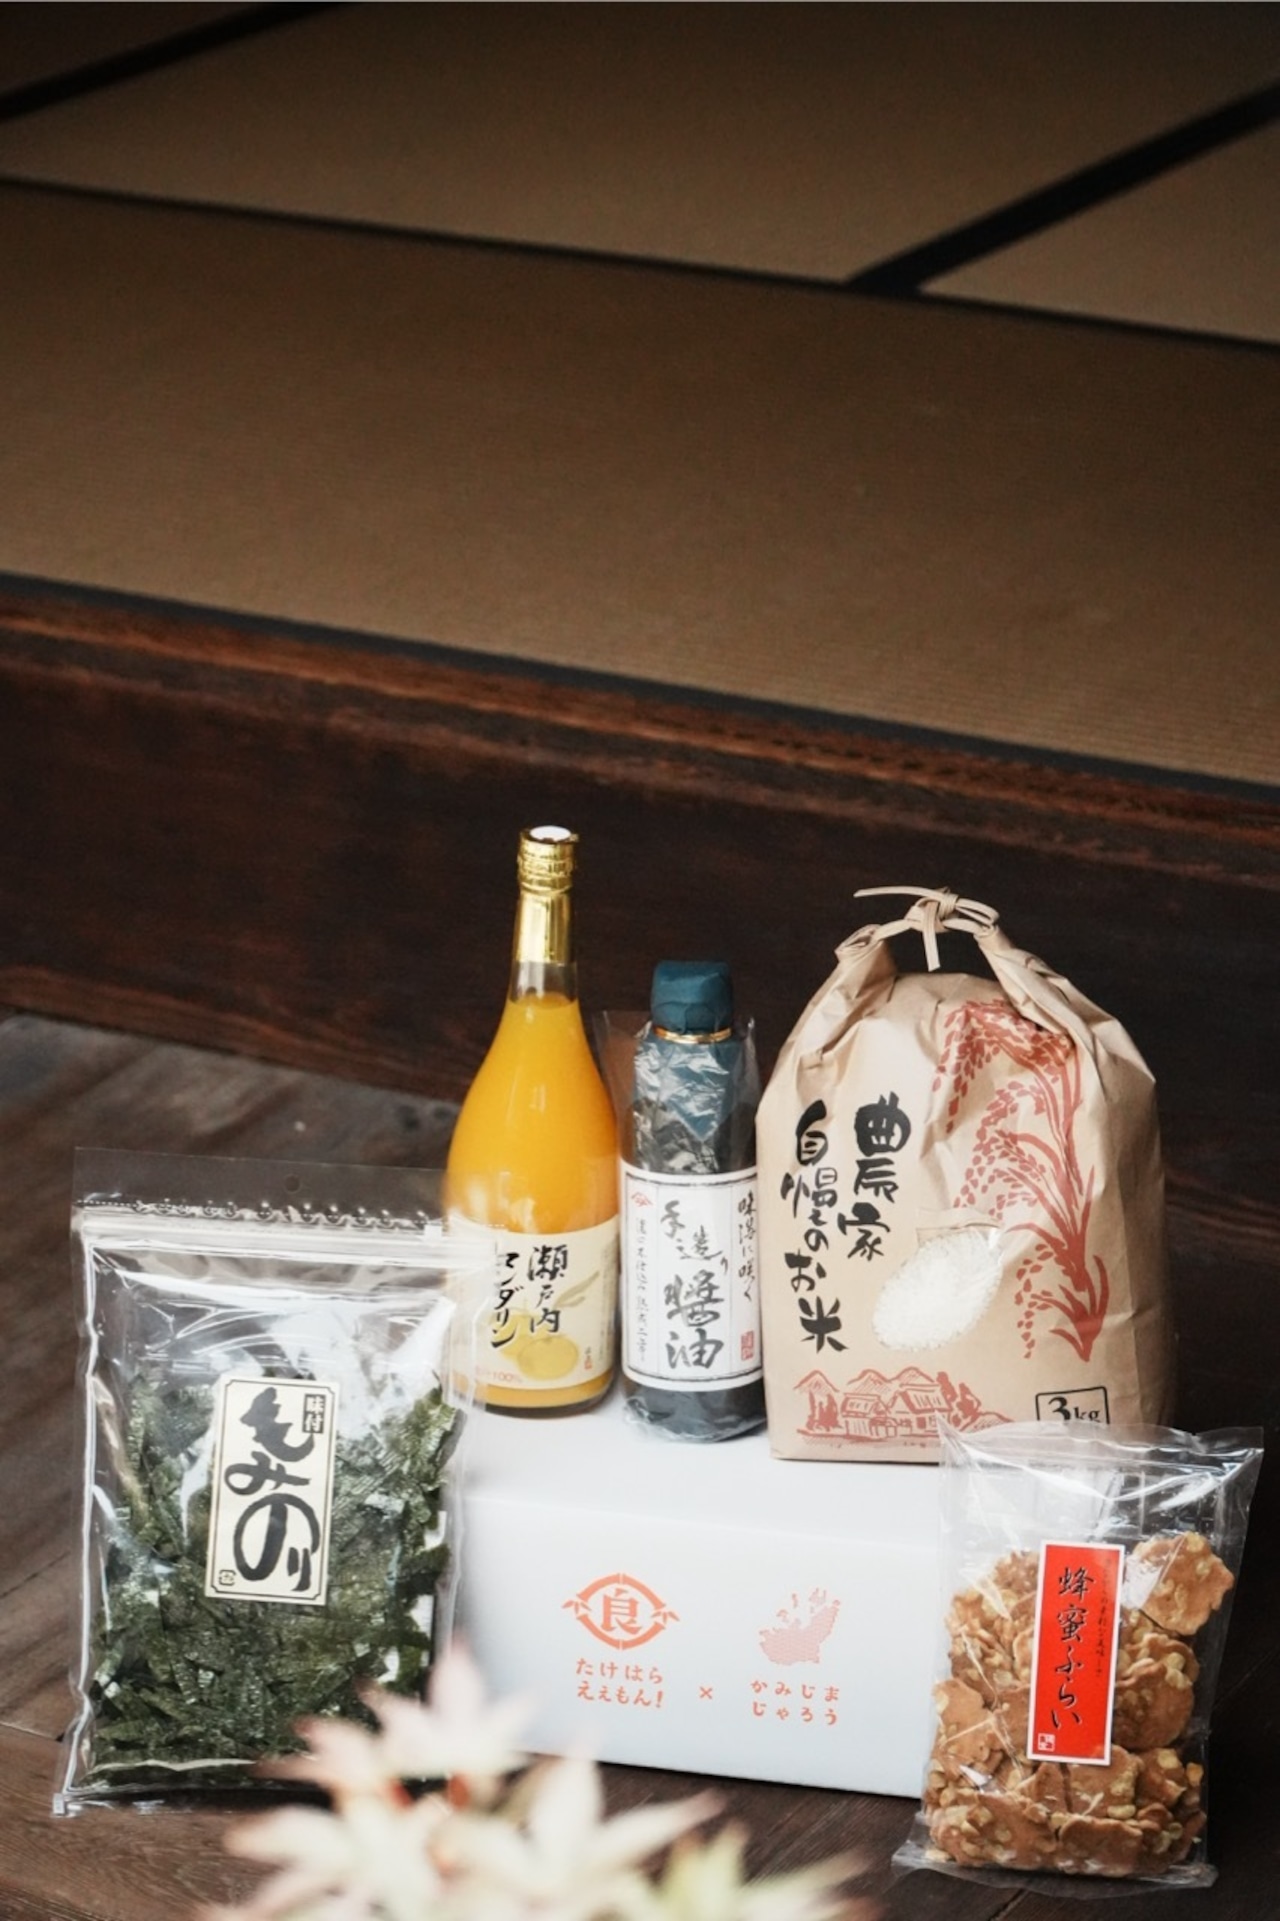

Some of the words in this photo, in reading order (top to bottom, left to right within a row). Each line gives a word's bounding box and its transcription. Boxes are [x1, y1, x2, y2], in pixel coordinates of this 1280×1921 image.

[837, 1092, 911, 1261] 農家
[780, 1100, 849, 1354] 自慢のお米
[491, 1252, 524, 1348] マンダリン
[527, 1244, 567, 1333] 瀬戸内
[1048, 1396, 1101, 1424] 3kg
[224, 1387, 321, 1591] もみのり
[600, 1588, 642, 1635] 良
[575, 1658, 663, 1684] たけはら
[751, 1679, 839, 1701] かみじま
[752, 1701, 837, 1725] じゃろう
